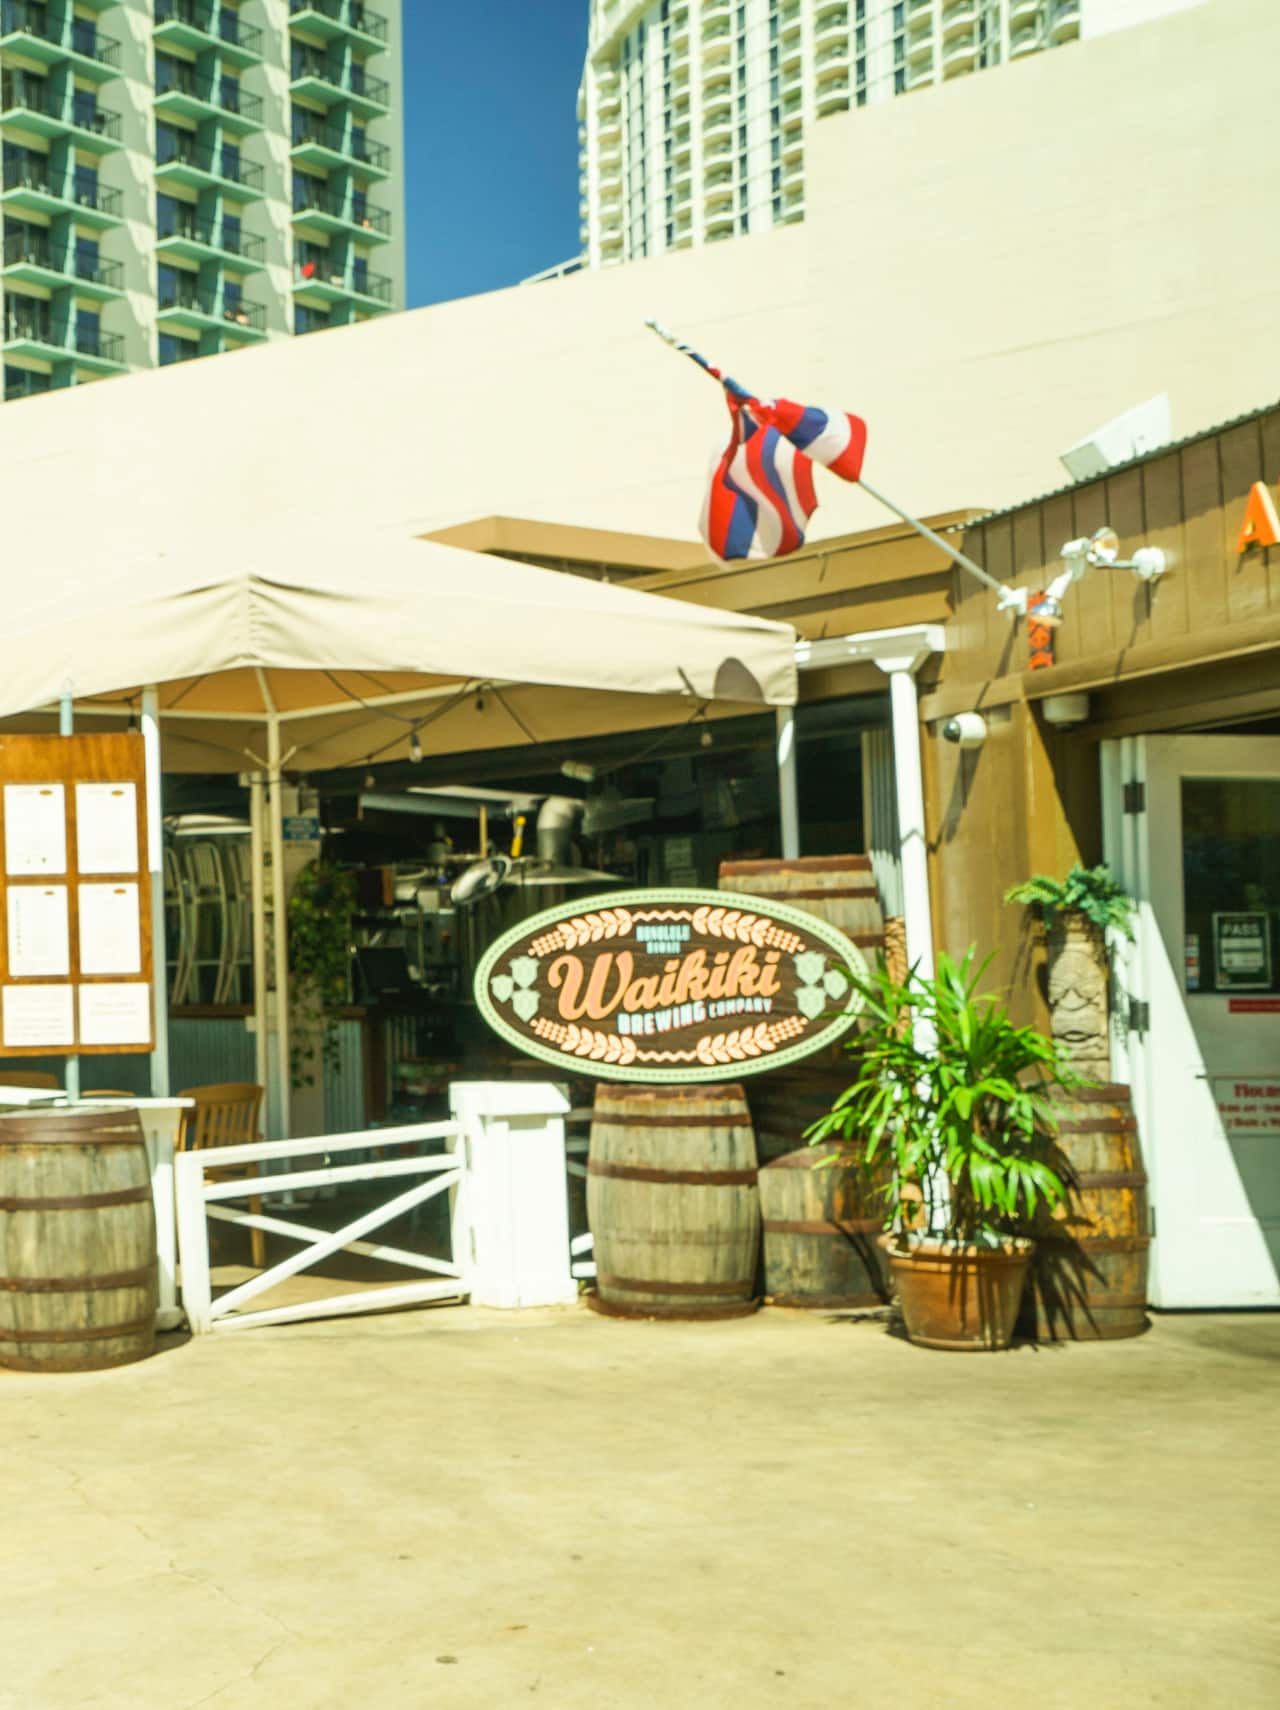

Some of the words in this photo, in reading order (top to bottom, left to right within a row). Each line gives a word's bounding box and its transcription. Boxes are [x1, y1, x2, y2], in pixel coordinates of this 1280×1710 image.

[1221, 923, 1260, 936] PASS
[548, 945, 781, 1021] Waikiki
[617, 1000, 706, 1035] BREWING
[708, 998, 772, 1019] COMPANY
